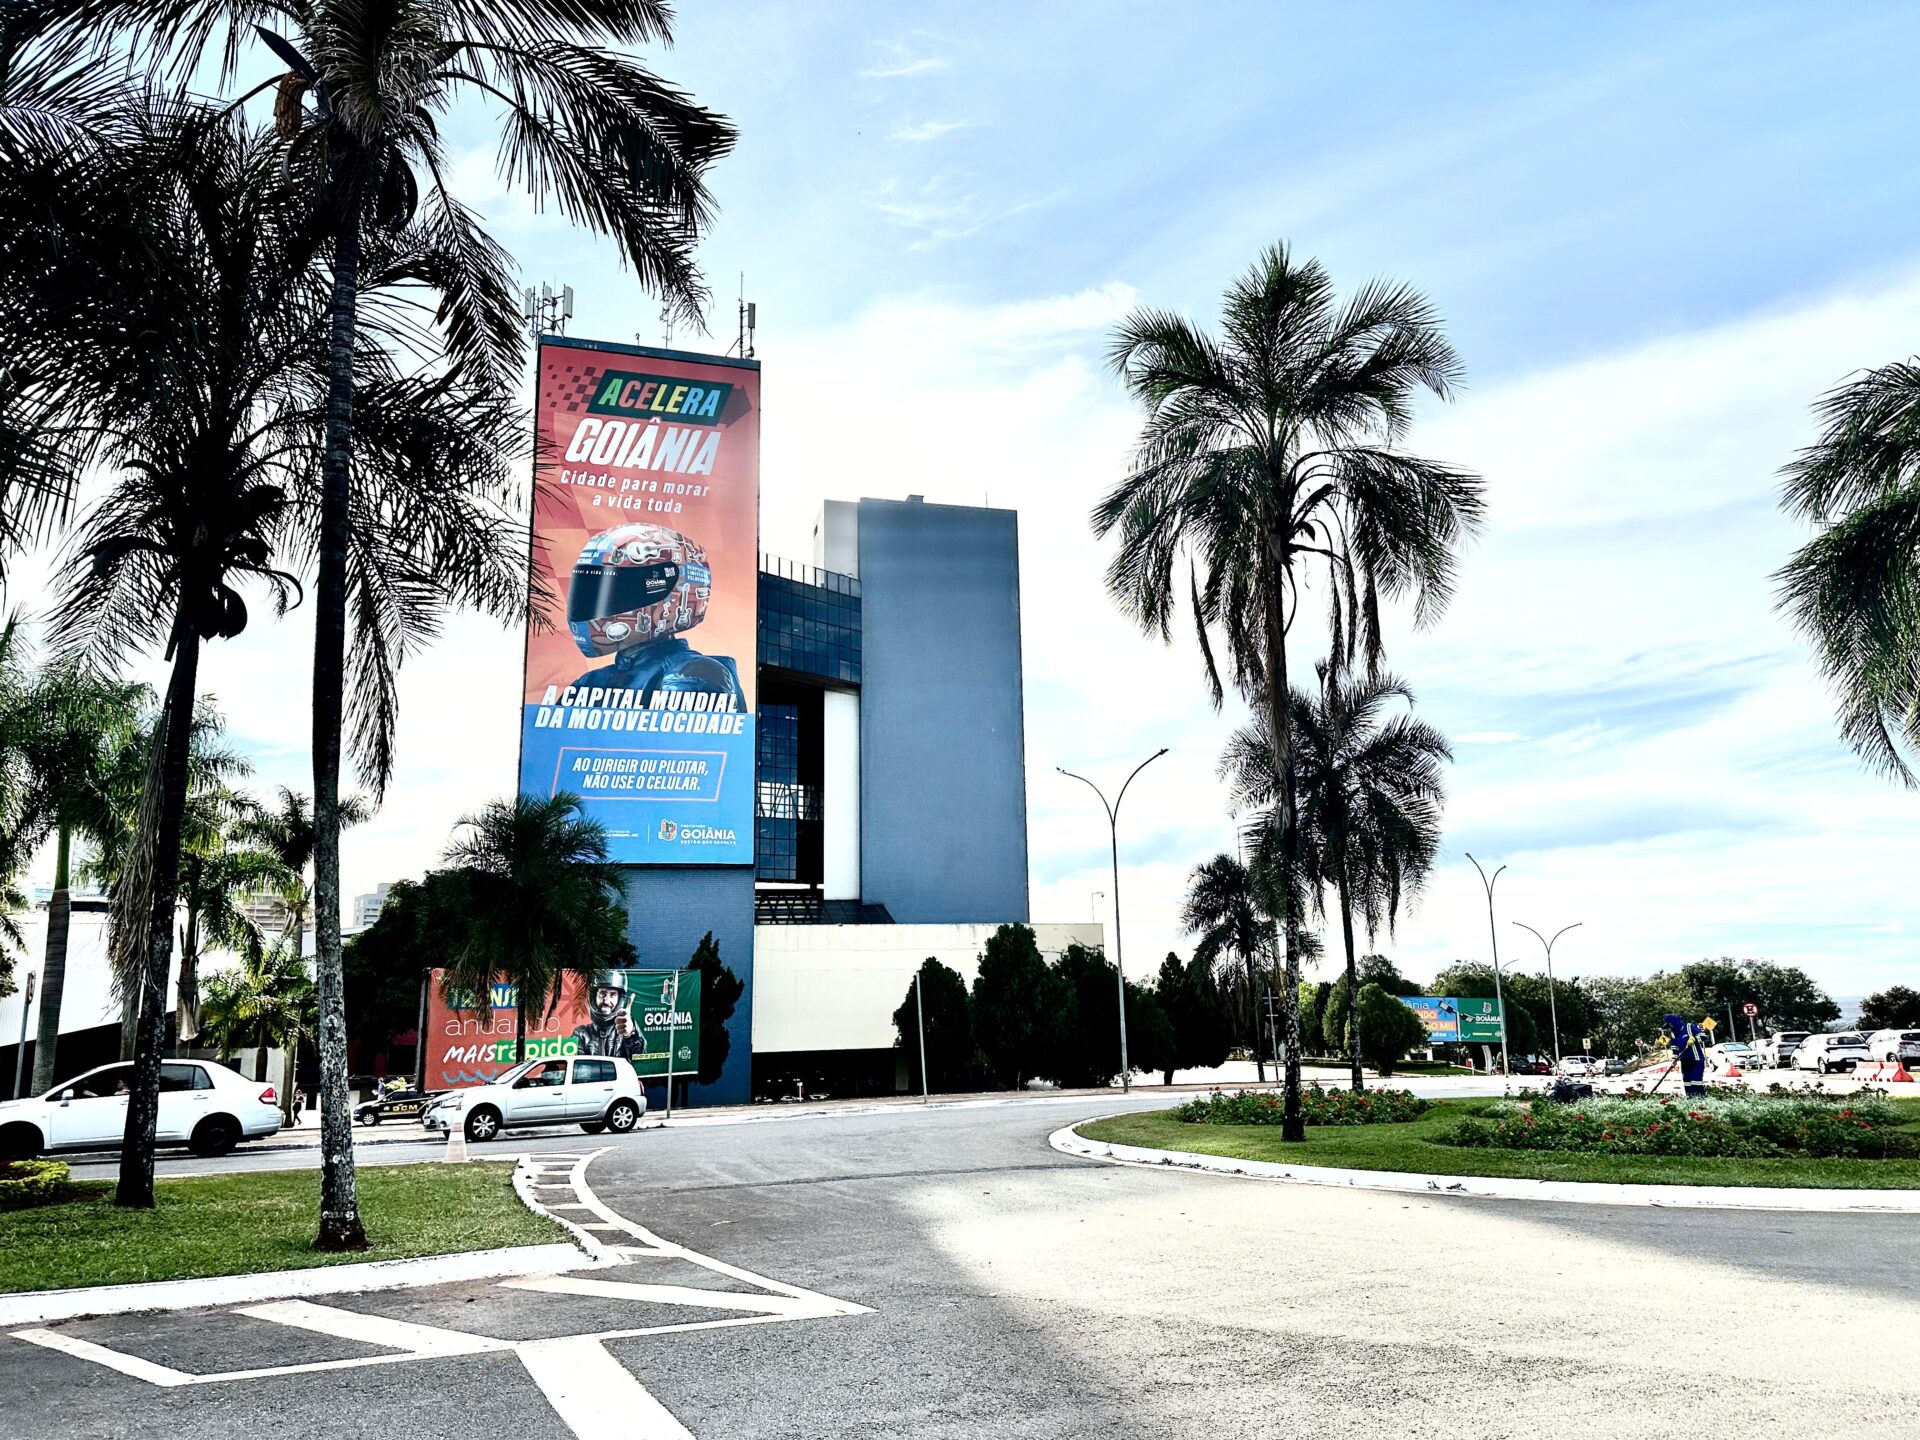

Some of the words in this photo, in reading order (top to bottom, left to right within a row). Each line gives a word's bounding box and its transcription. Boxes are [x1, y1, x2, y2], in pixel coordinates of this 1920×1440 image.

[598, 378, 721, 417] ACELERA
[564, 416, 722, 476] GOIÂNIA
[560, 470, 615, 488] Cidade
[620, 477, 657, 495] para
[663, 483, 711, 497] morar
[592, 495, 601, 507] a
[608, 494, 641, 510] vida
[647, 497, 683, 514] toda
[541, 684, 558, 706] A
[560, 686, 644, 710] CAPITAL
[649, 690, 738, 713] MUNDIAL
[534, 707, 564, 729] DA
[567, 708, 745, 735] MOTOVELOCIDADE
[572, 757, 591, 772] AO
[592, 758, 637, 774] DIRIGIR
[640, 759, 657, 773] OU
[658, 760, 709, 776] PILOTAR,
[582, 771, 608, 789] NÃO
[610, 775, 634, 789] USE
[635, 776, 642, 789] O
[646, 775, 701, 791] CELULAR.
[680, 827, 736, 840] GOIÂNIA
[644, 1009, 693, 1026] GOIÂNIA
[443, 1043, 498, 1064] MAIS
